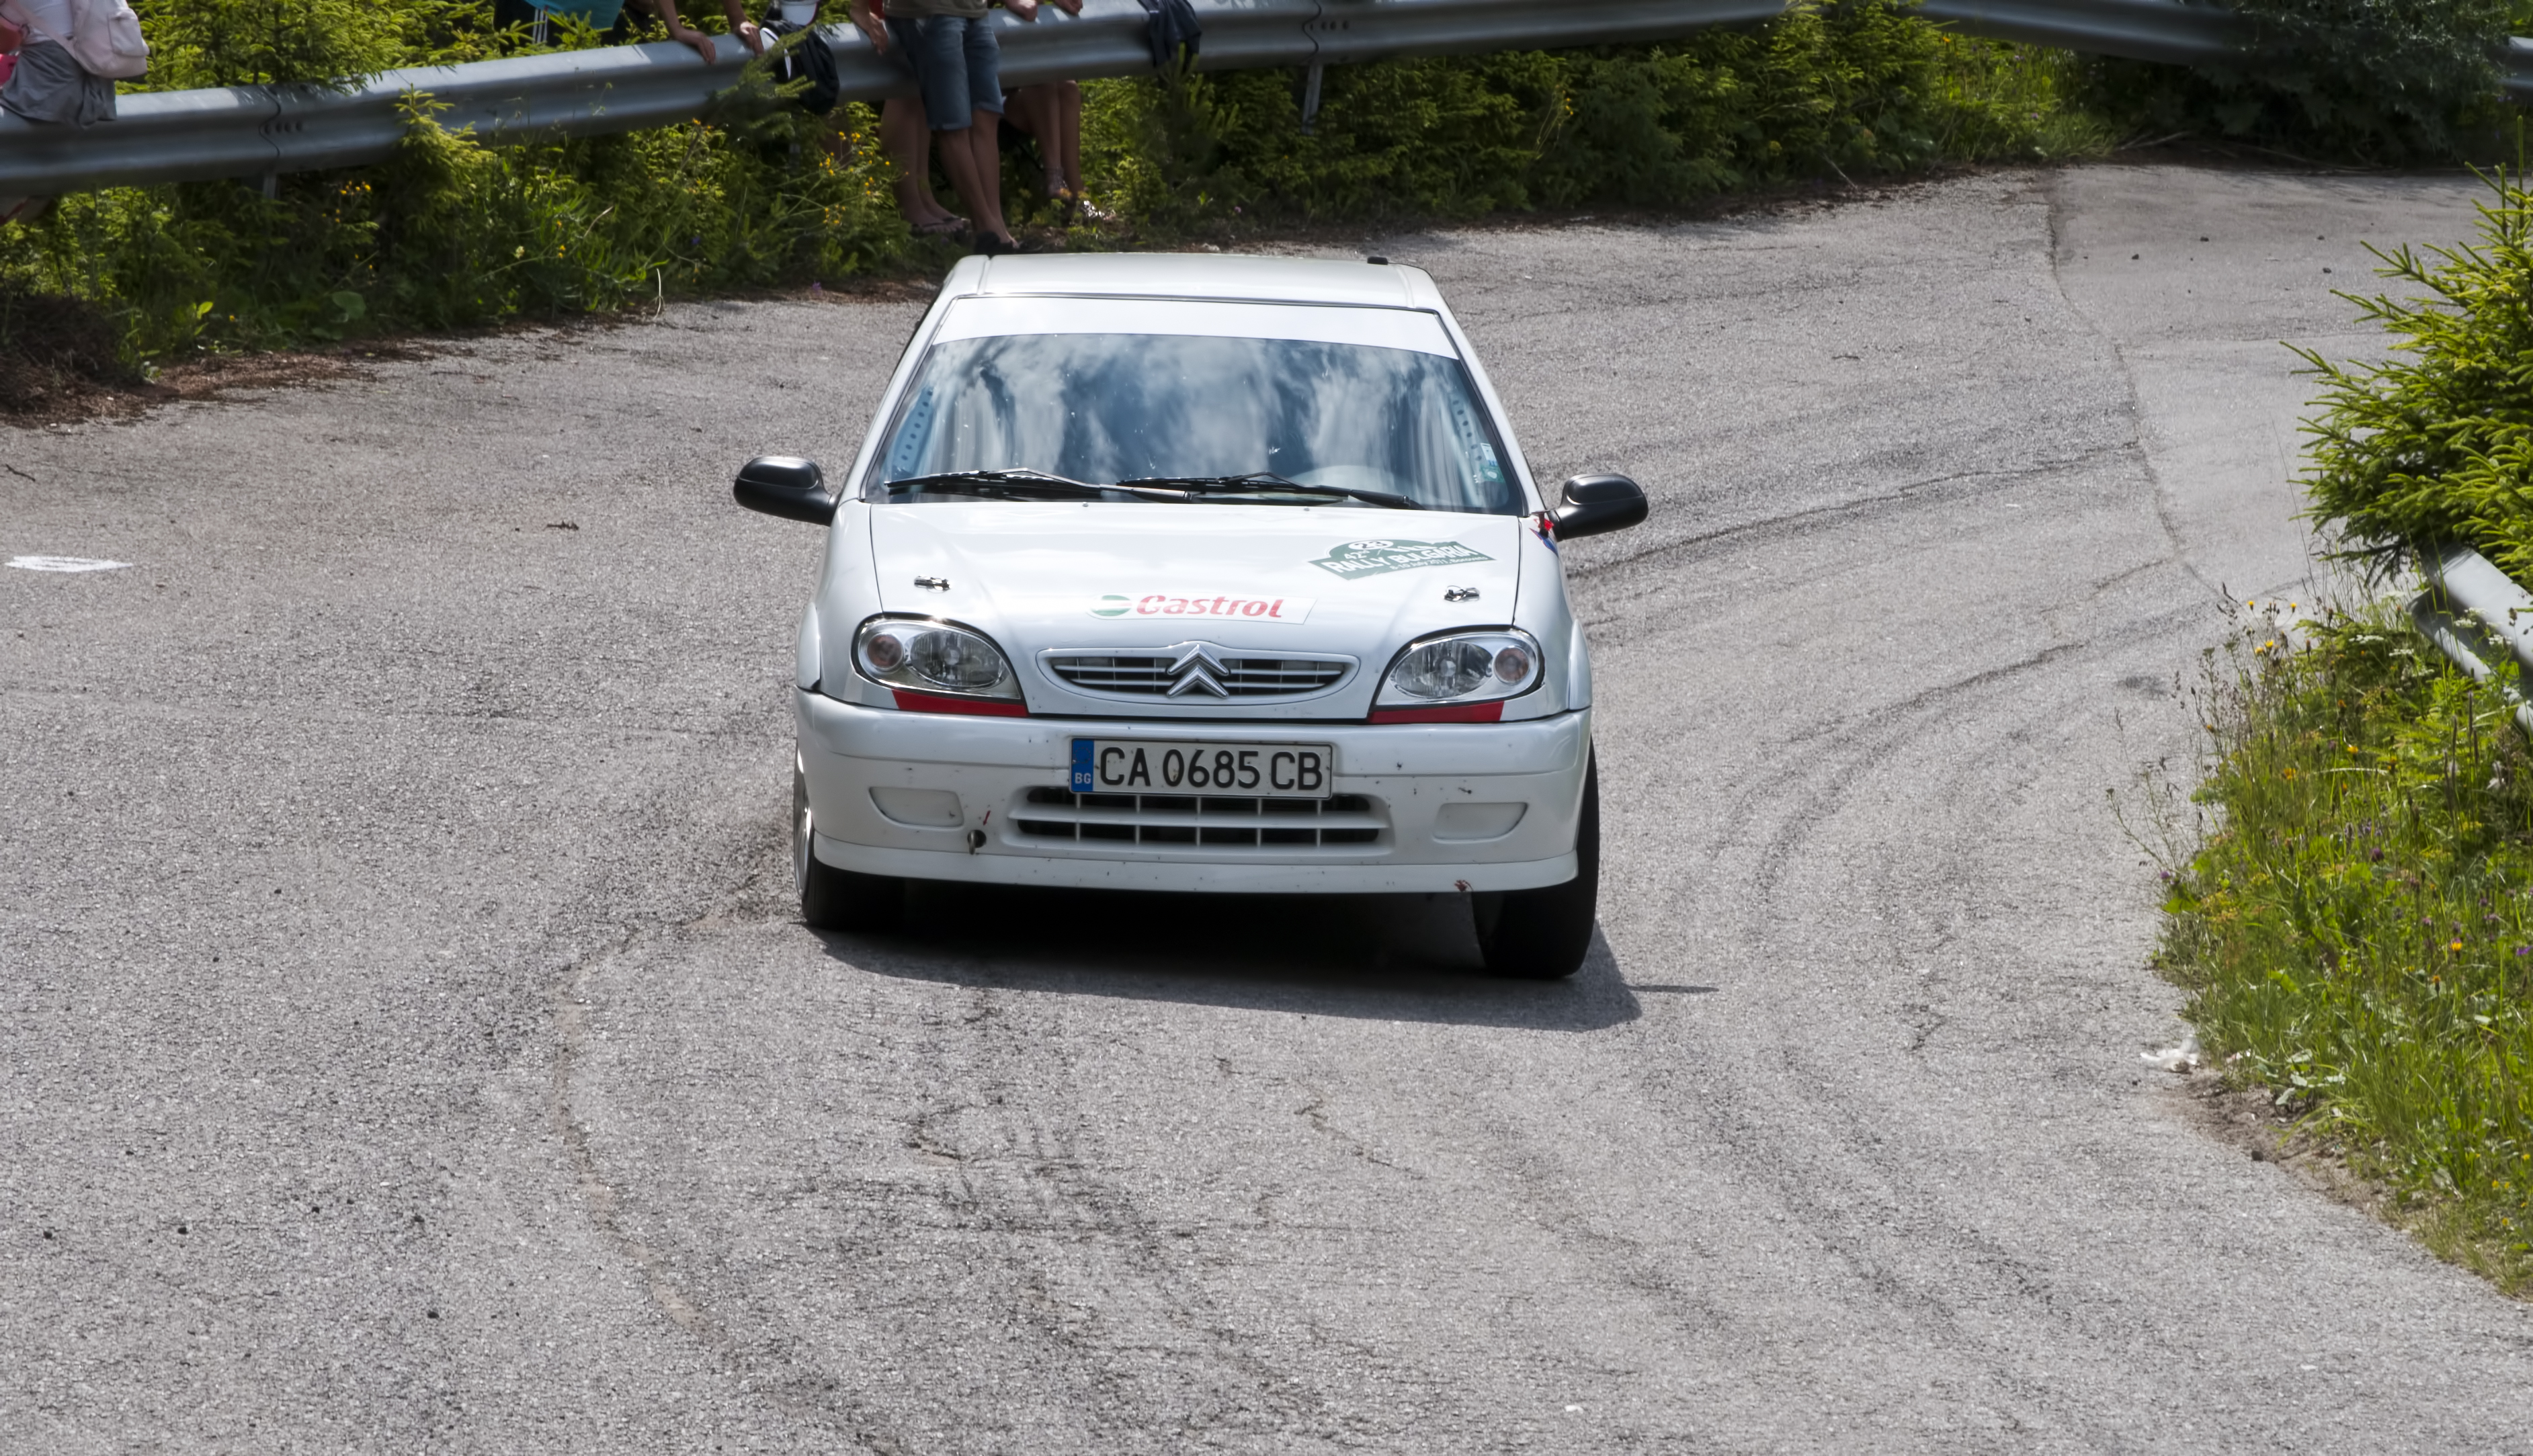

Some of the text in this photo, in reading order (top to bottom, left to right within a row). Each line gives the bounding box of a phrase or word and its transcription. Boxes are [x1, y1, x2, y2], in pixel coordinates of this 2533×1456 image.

[1321, 545, 1479, 573] RALLY BULGARIA
[1136, 595, 1284, 618] Castrol
[1075, 772, 1091, 785] BG
[1099, 747, 1323, 791] CA 0685 CB
